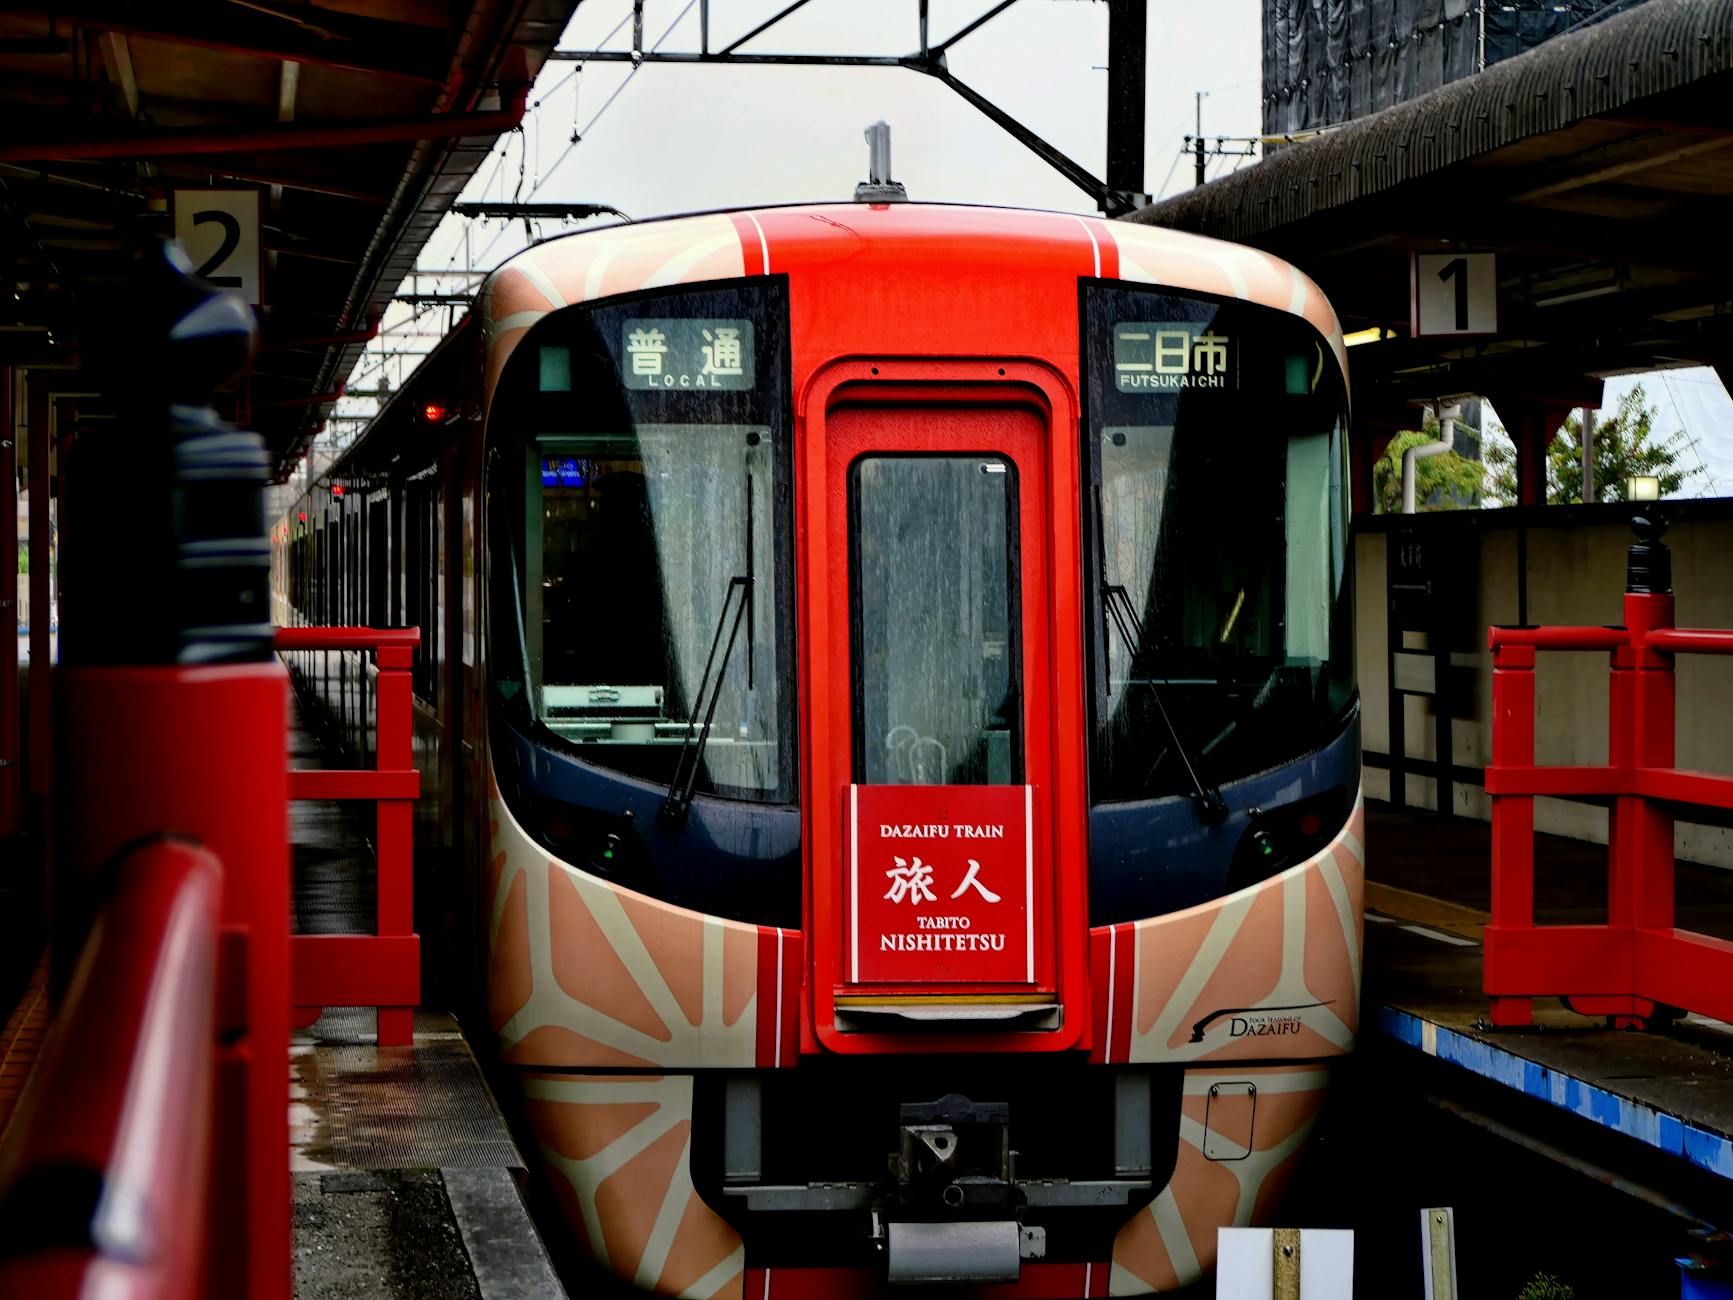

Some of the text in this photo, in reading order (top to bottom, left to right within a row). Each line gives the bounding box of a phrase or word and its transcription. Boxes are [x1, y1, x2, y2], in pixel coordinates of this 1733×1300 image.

[193, 211, 242, 287] 2
[1438, 258, 1468, 330] 1
[626, 327, 743, 375] 普通
[1116, 330, 1229, 375] 二日市
[648, 374, 721, 387] LOCAL
[1120, 375, 1224, 388] FUTSUKAICHI
[880, 824, 1004, 838] DAZAIFU TRAIN
[883, 856, 1002, 906] 旅人
[916, 916, 971, 929] TABITO
[880, 934, 1005, 951] NISHITETSU
[1230, 1017, 1300, 1037] DAZAIFU
